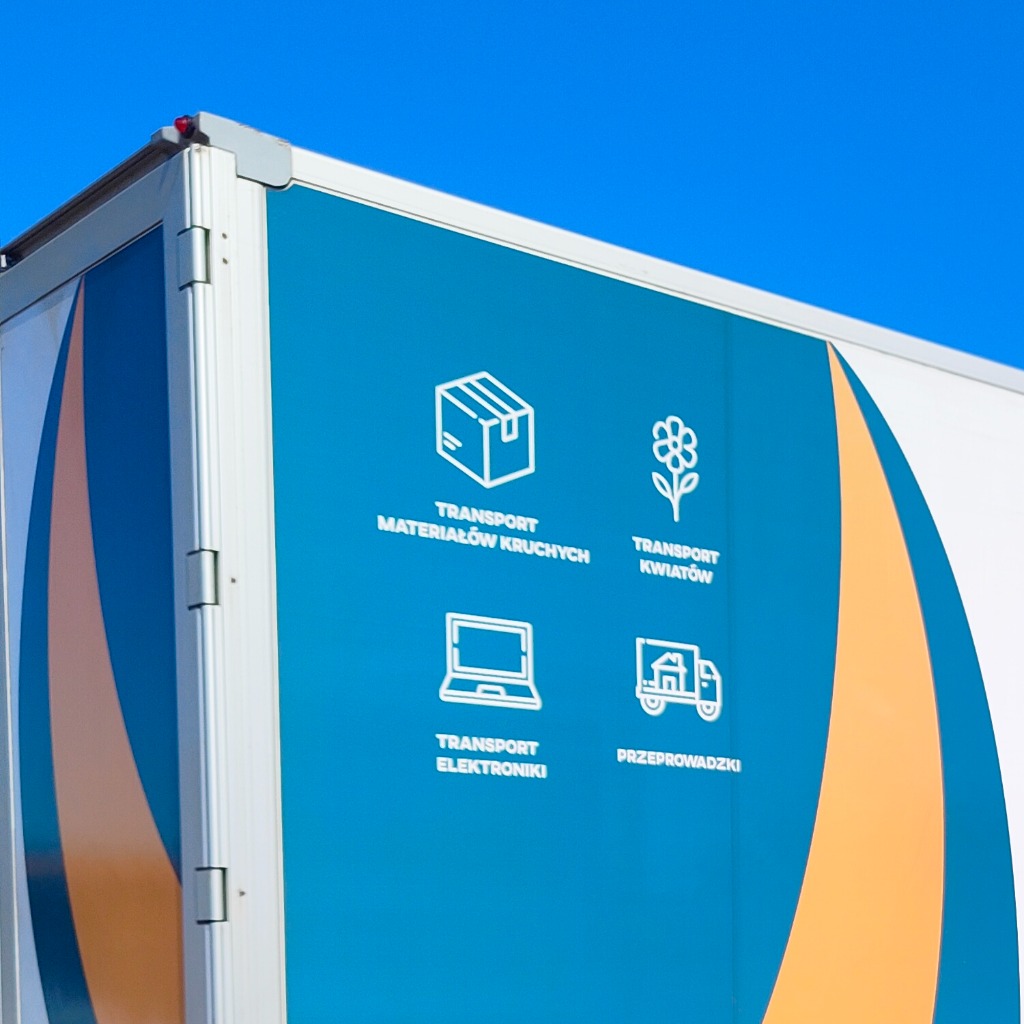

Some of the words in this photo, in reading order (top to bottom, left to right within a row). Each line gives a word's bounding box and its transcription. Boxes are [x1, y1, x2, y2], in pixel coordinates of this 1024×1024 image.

[435, 501, 539, 533] TRANSPORT
[377, 515, 498, 549] MATERIAŁÓW
[500, 535, 591, 564] KRUCHYCH
[632, 536, 720, 565] TRANSPORT
[639, 558, 714, 585] KWIATÓW
[435, 733, 540, 756] TRANSPORT
[436, 756, 548, 780] ELEKTRONIKI
[616, 748, 742, 774] PRZEPROWADZKI
